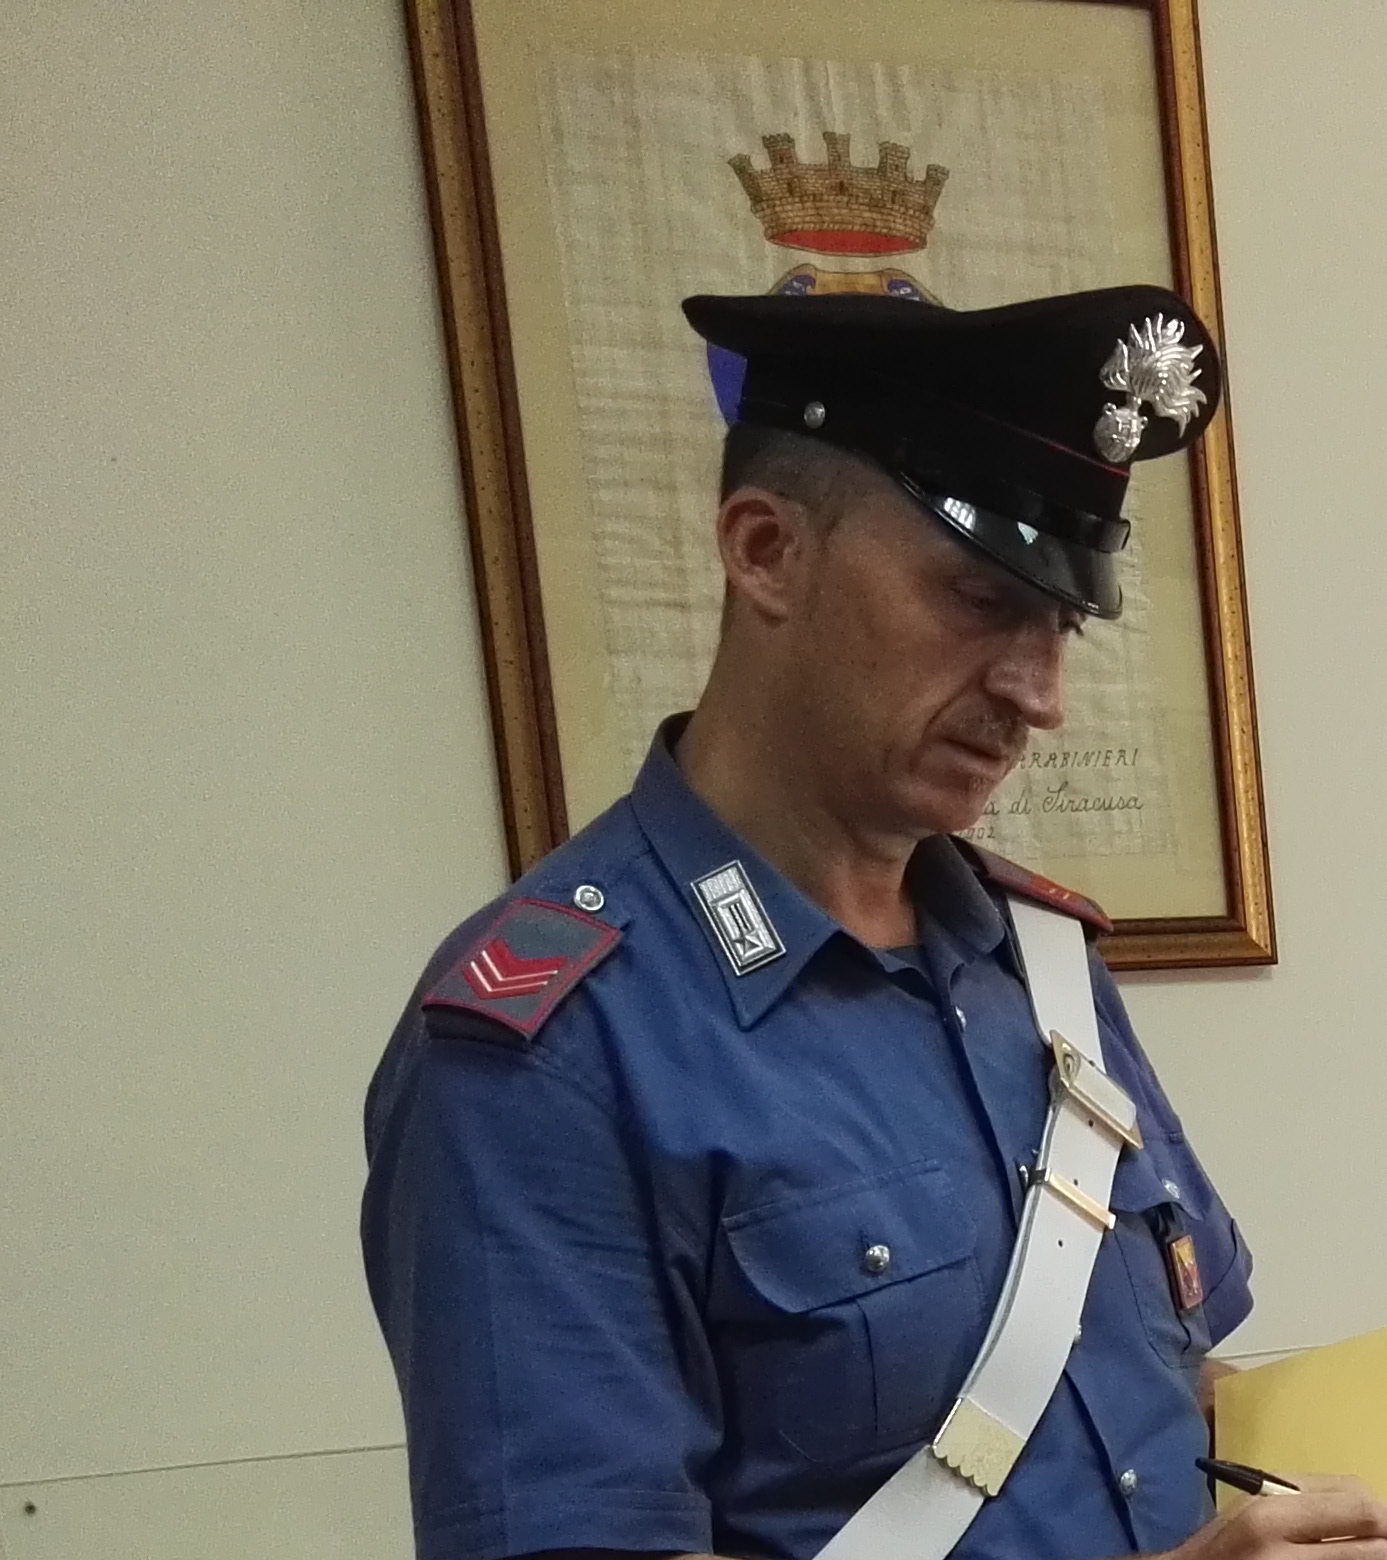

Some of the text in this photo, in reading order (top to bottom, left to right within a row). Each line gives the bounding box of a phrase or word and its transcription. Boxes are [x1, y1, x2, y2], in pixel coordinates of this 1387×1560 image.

[1016, 748, 1139, 770] ARABINIERI
[1008, 784, 1032, 815] di
[1042, 780, 1144, 814] Siracusa
